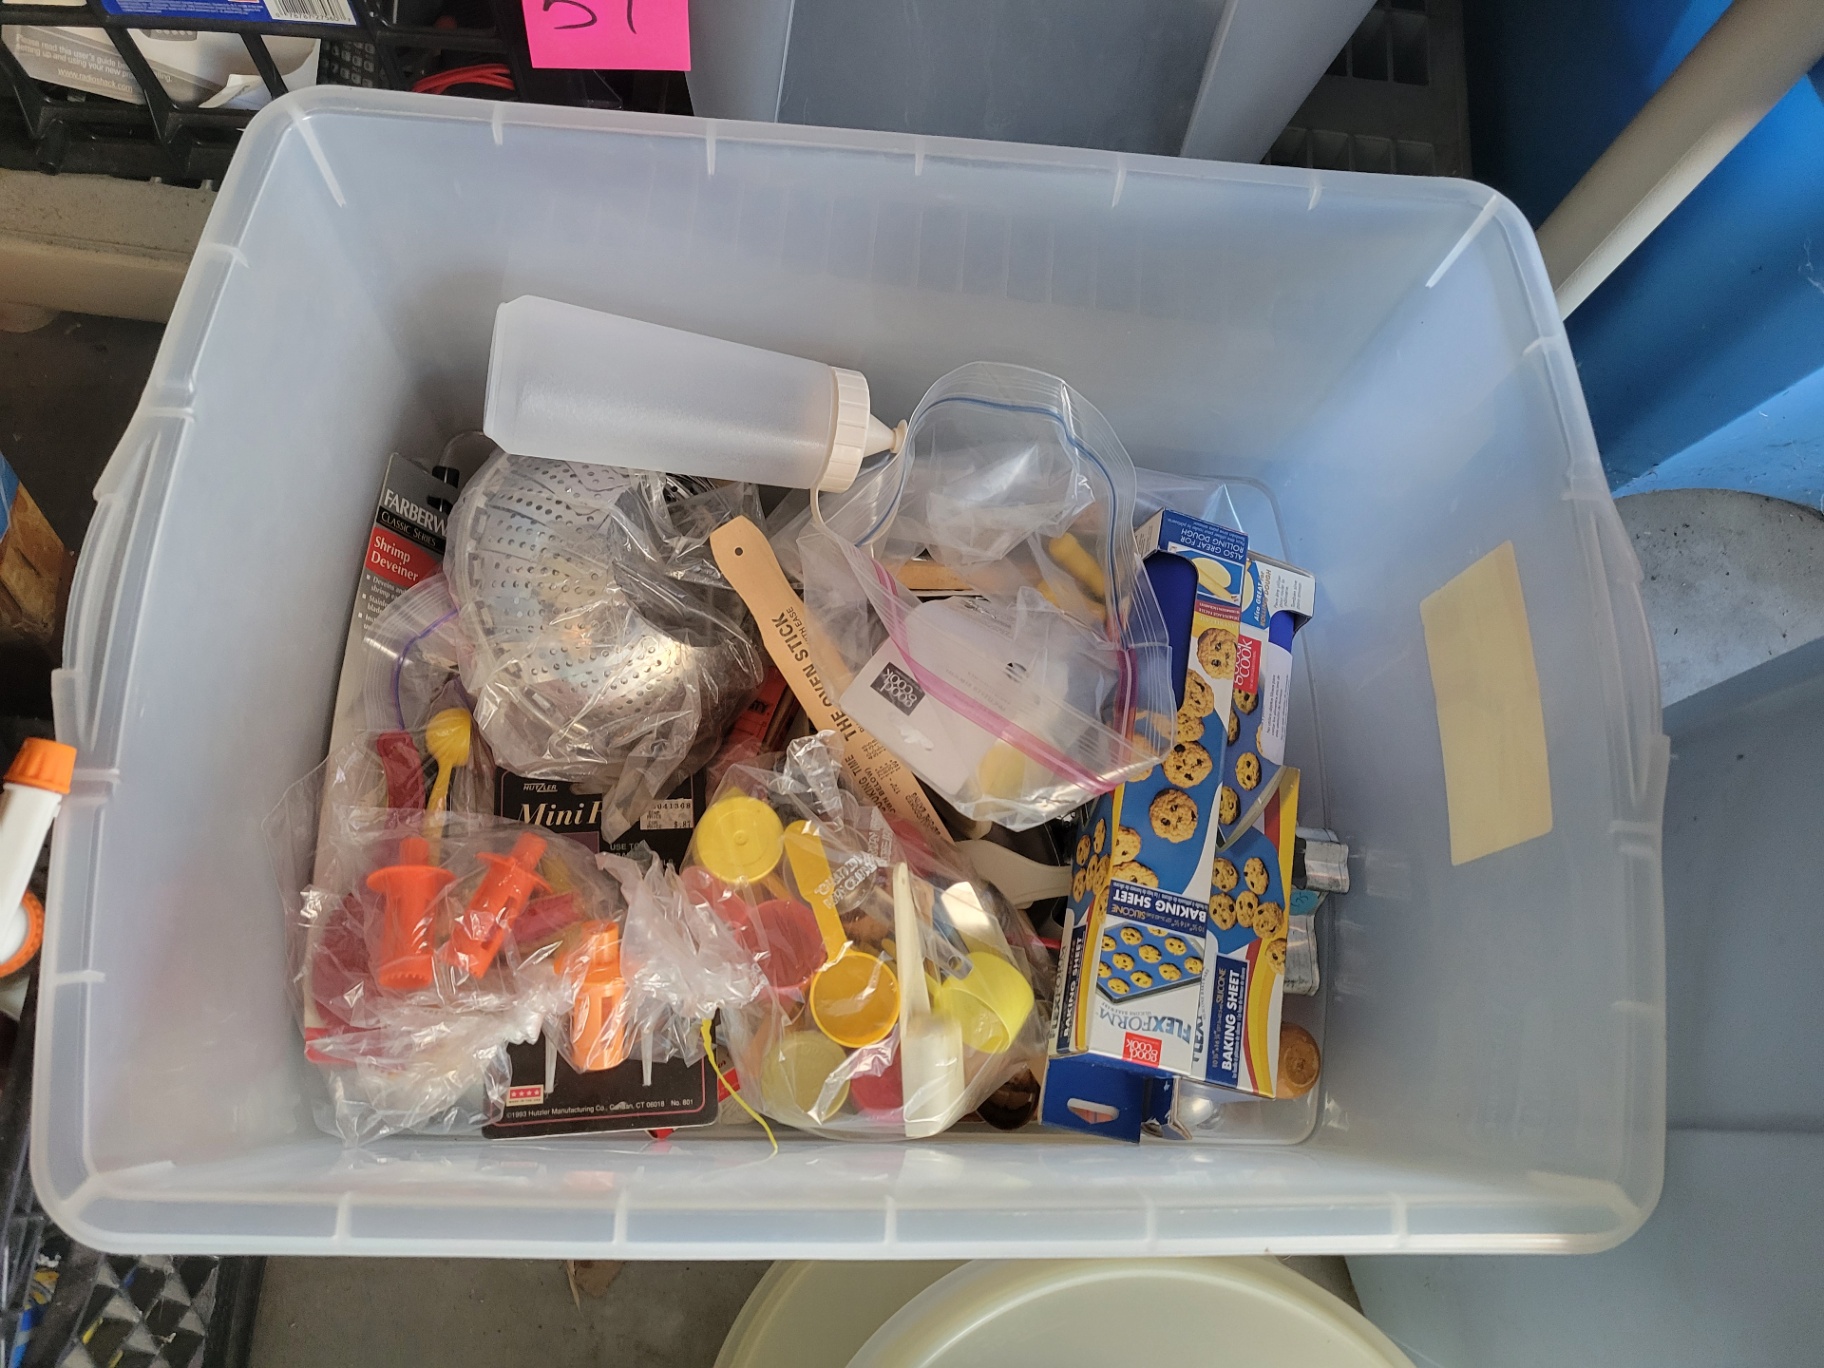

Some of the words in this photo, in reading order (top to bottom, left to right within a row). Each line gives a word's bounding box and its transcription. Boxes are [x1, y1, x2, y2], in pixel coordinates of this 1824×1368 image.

[41, 41, 57, 52] read
[59, 45, 72, 56] this
[73, 50, 95, 61] user's
[97, 56, 116, 67] guide
[53, 52, 67, 62] and
[68, 55, 87, 68] using
[88, 61, 104, 73] your
[105, 66, 120, 75] new
[57, 68, 133, 93] www.radioshack.com
[384, 488, 447, 537] FARBERW
[381, 511, 411, 534] CLASSIC
[413, 527, 436, 546] SERIES
[1180, 528, 1210, 542] DOUGH
[1180, 535, 1195, 545] FOR
[374, 535, 410, 564] Shrimp
[1196, 541, 1221, 553] GREAT
[1212, 537, 1243, 552] ROLLING
[1223, 549, 1243, 559] ALSO
[371, 550, 419, 581] Deveiner
[785, 606, 802, 627] EASE
[772, 611, 809, 661] STICK
[1238, 638, 1252, 677] cook
[883, 668, 912, 693] cook
[879, 681, 917, 706] good
[830, 708, 857, 741] THE
[844, 753, 862, 776] TIME
[523, 782, 558, 793] HUTZLER
[863, 766, 886, 796] BELOW)
[518, 802, 584, 826] Mini
[1111, 903, 1145, 919] SILICONE
[1112, 889, 1151, 909] SHEET
[1154, 899, 1206, 922] BAKING
[1063, 980, 1075, 1036] BAKING
[1072, 936, 1081, 976] SHEET
[1216, 967, 1226, 1003] SILICONE
[1227, 969, 1240, 1009] SHEET
[1099, 1006, 1190, 1044] FLEXFORM
[1126, 1038, 1151, 1052] cook
[1221, 1013, 1236, 1070] BAKING
[1129, 1048, 1157, 1062] good
[551, 1105, 594, 1114] Manufacturing
[635, 1101, 645, 1109] CT
